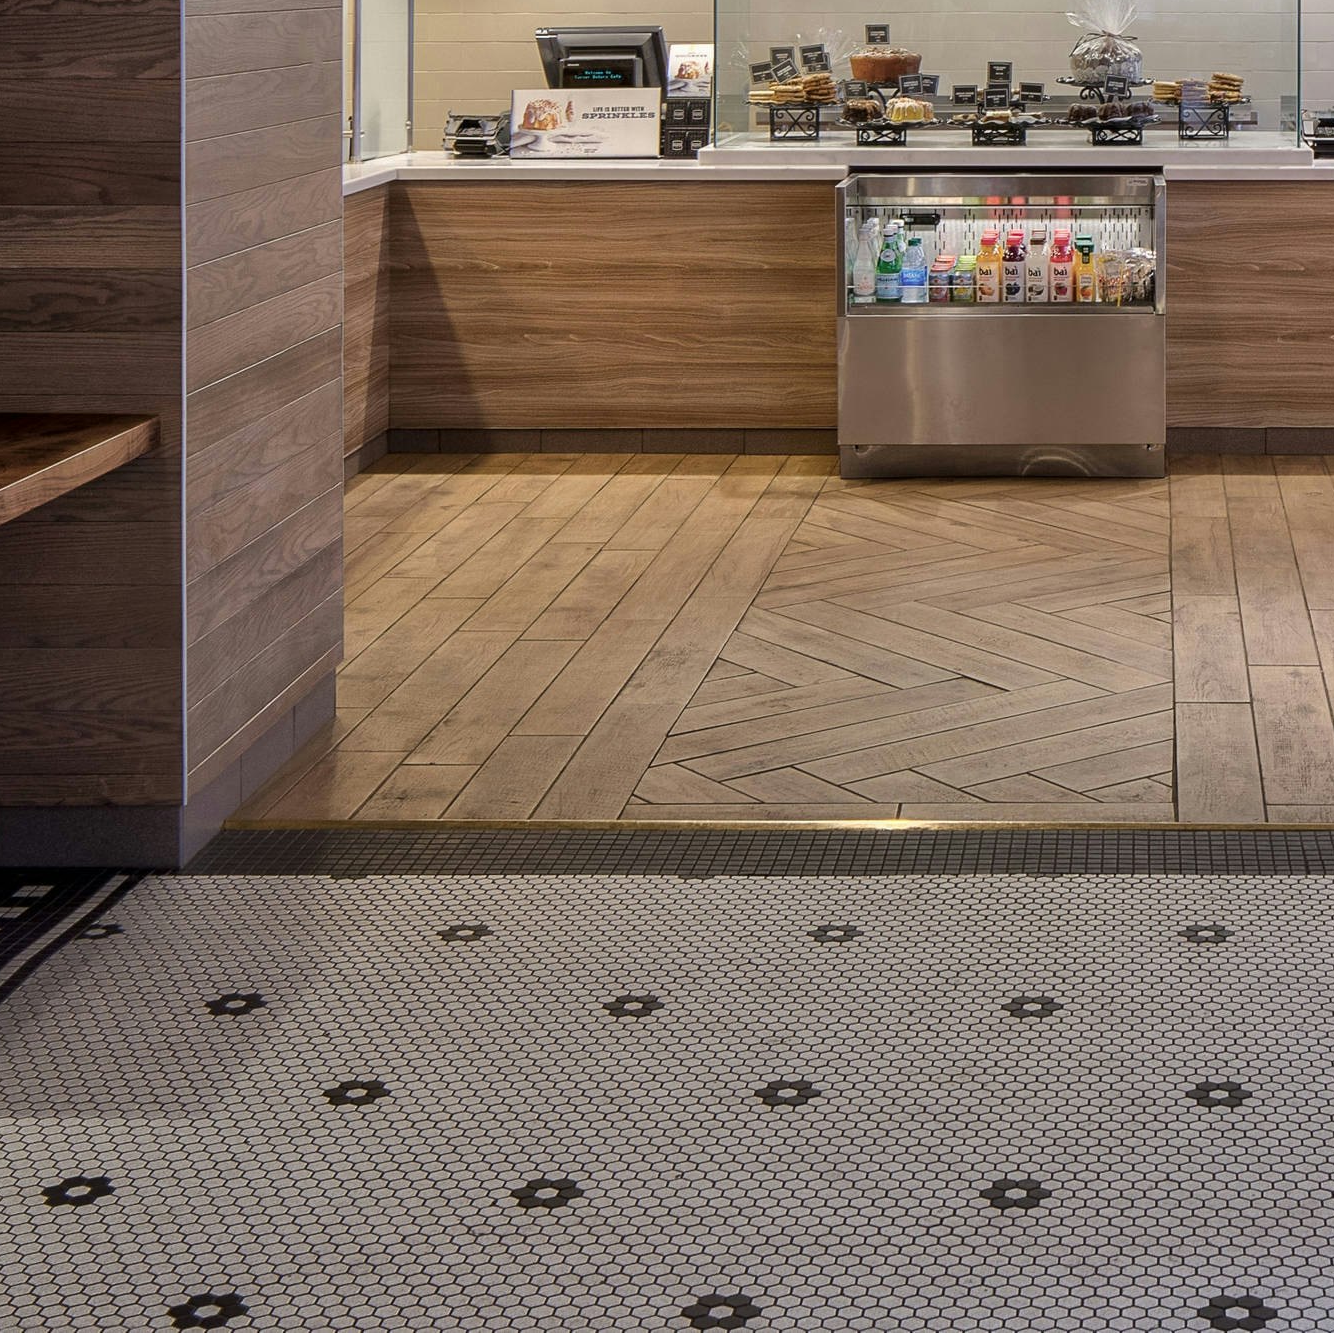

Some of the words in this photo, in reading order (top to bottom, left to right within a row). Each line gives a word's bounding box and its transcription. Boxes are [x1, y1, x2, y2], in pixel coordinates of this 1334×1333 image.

[581, 112, 656, 120] SPRINKLES
[979, 267, 992, 276] bai
[1005, 266, 1018, 276] bai
[1028, 267, 1041, 277] bai
[1054, 266, 1067, 276] bai
